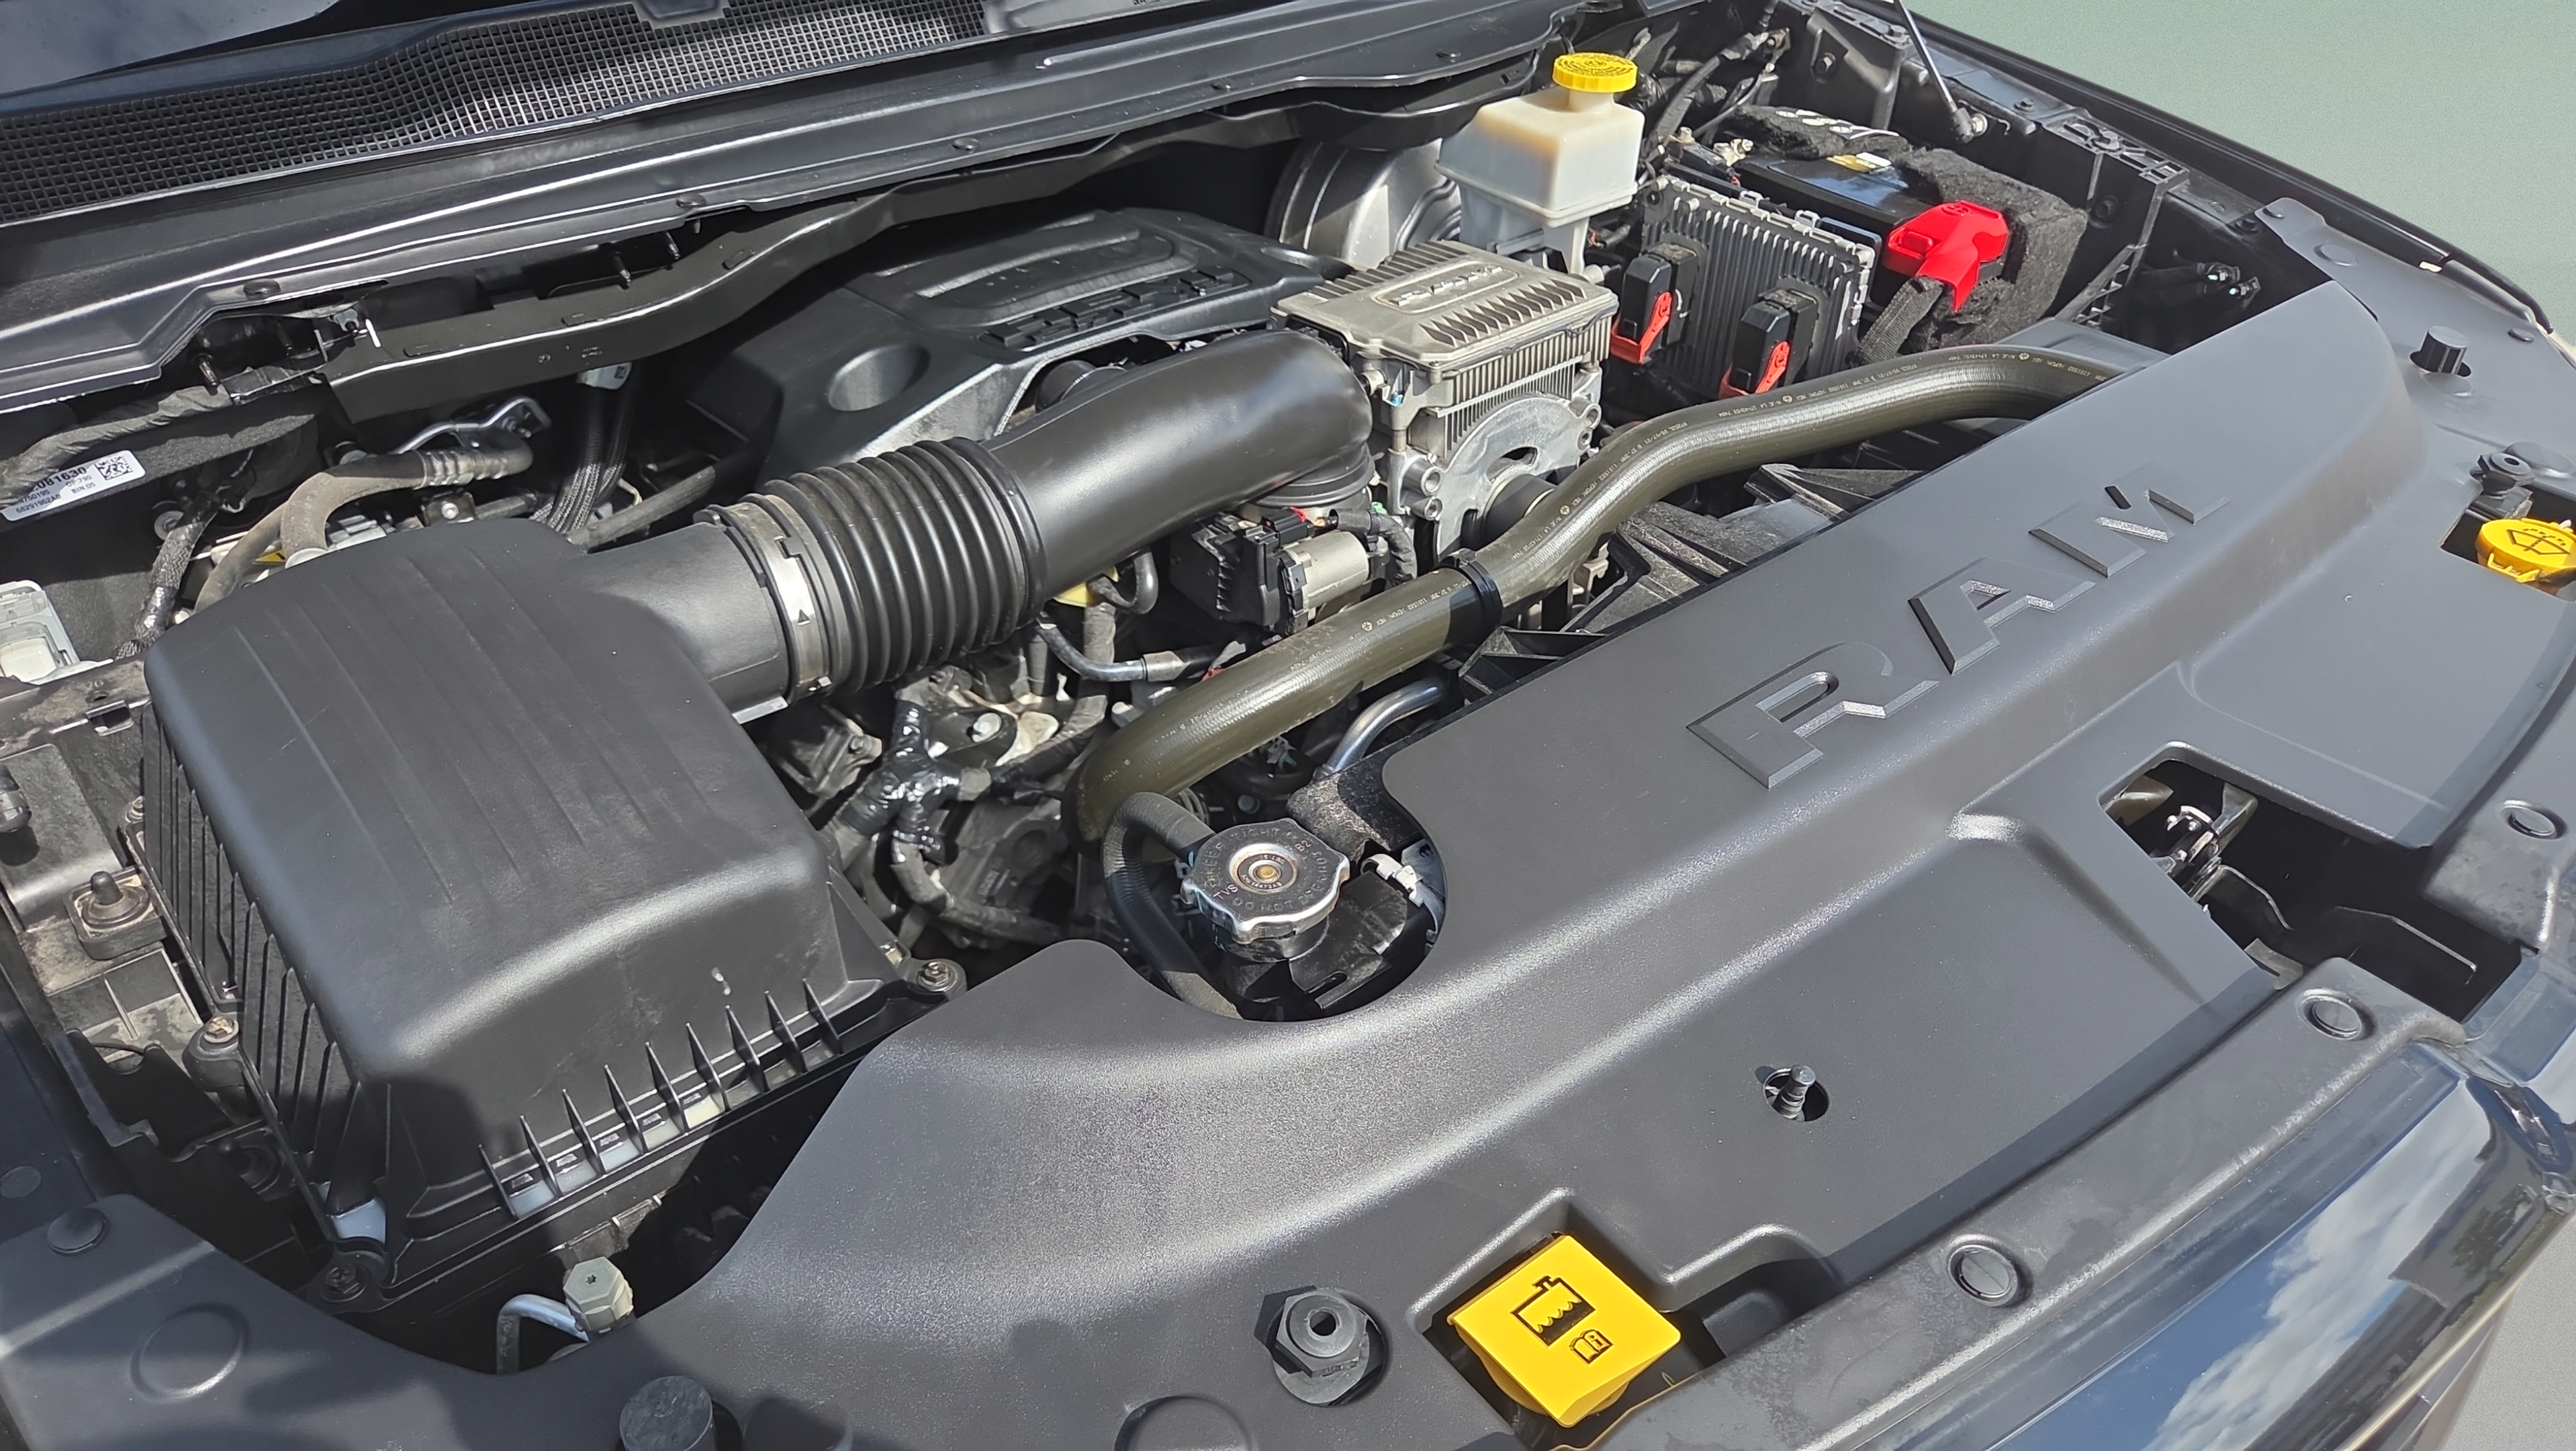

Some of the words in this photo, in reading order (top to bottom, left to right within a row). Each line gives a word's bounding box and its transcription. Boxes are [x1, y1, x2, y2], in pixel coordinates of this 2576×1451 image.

[1686, 461, 2229, 789] RAM
[1295, 839, 1312, 852] B2
[1213, 883, 1238, 900] TVS
